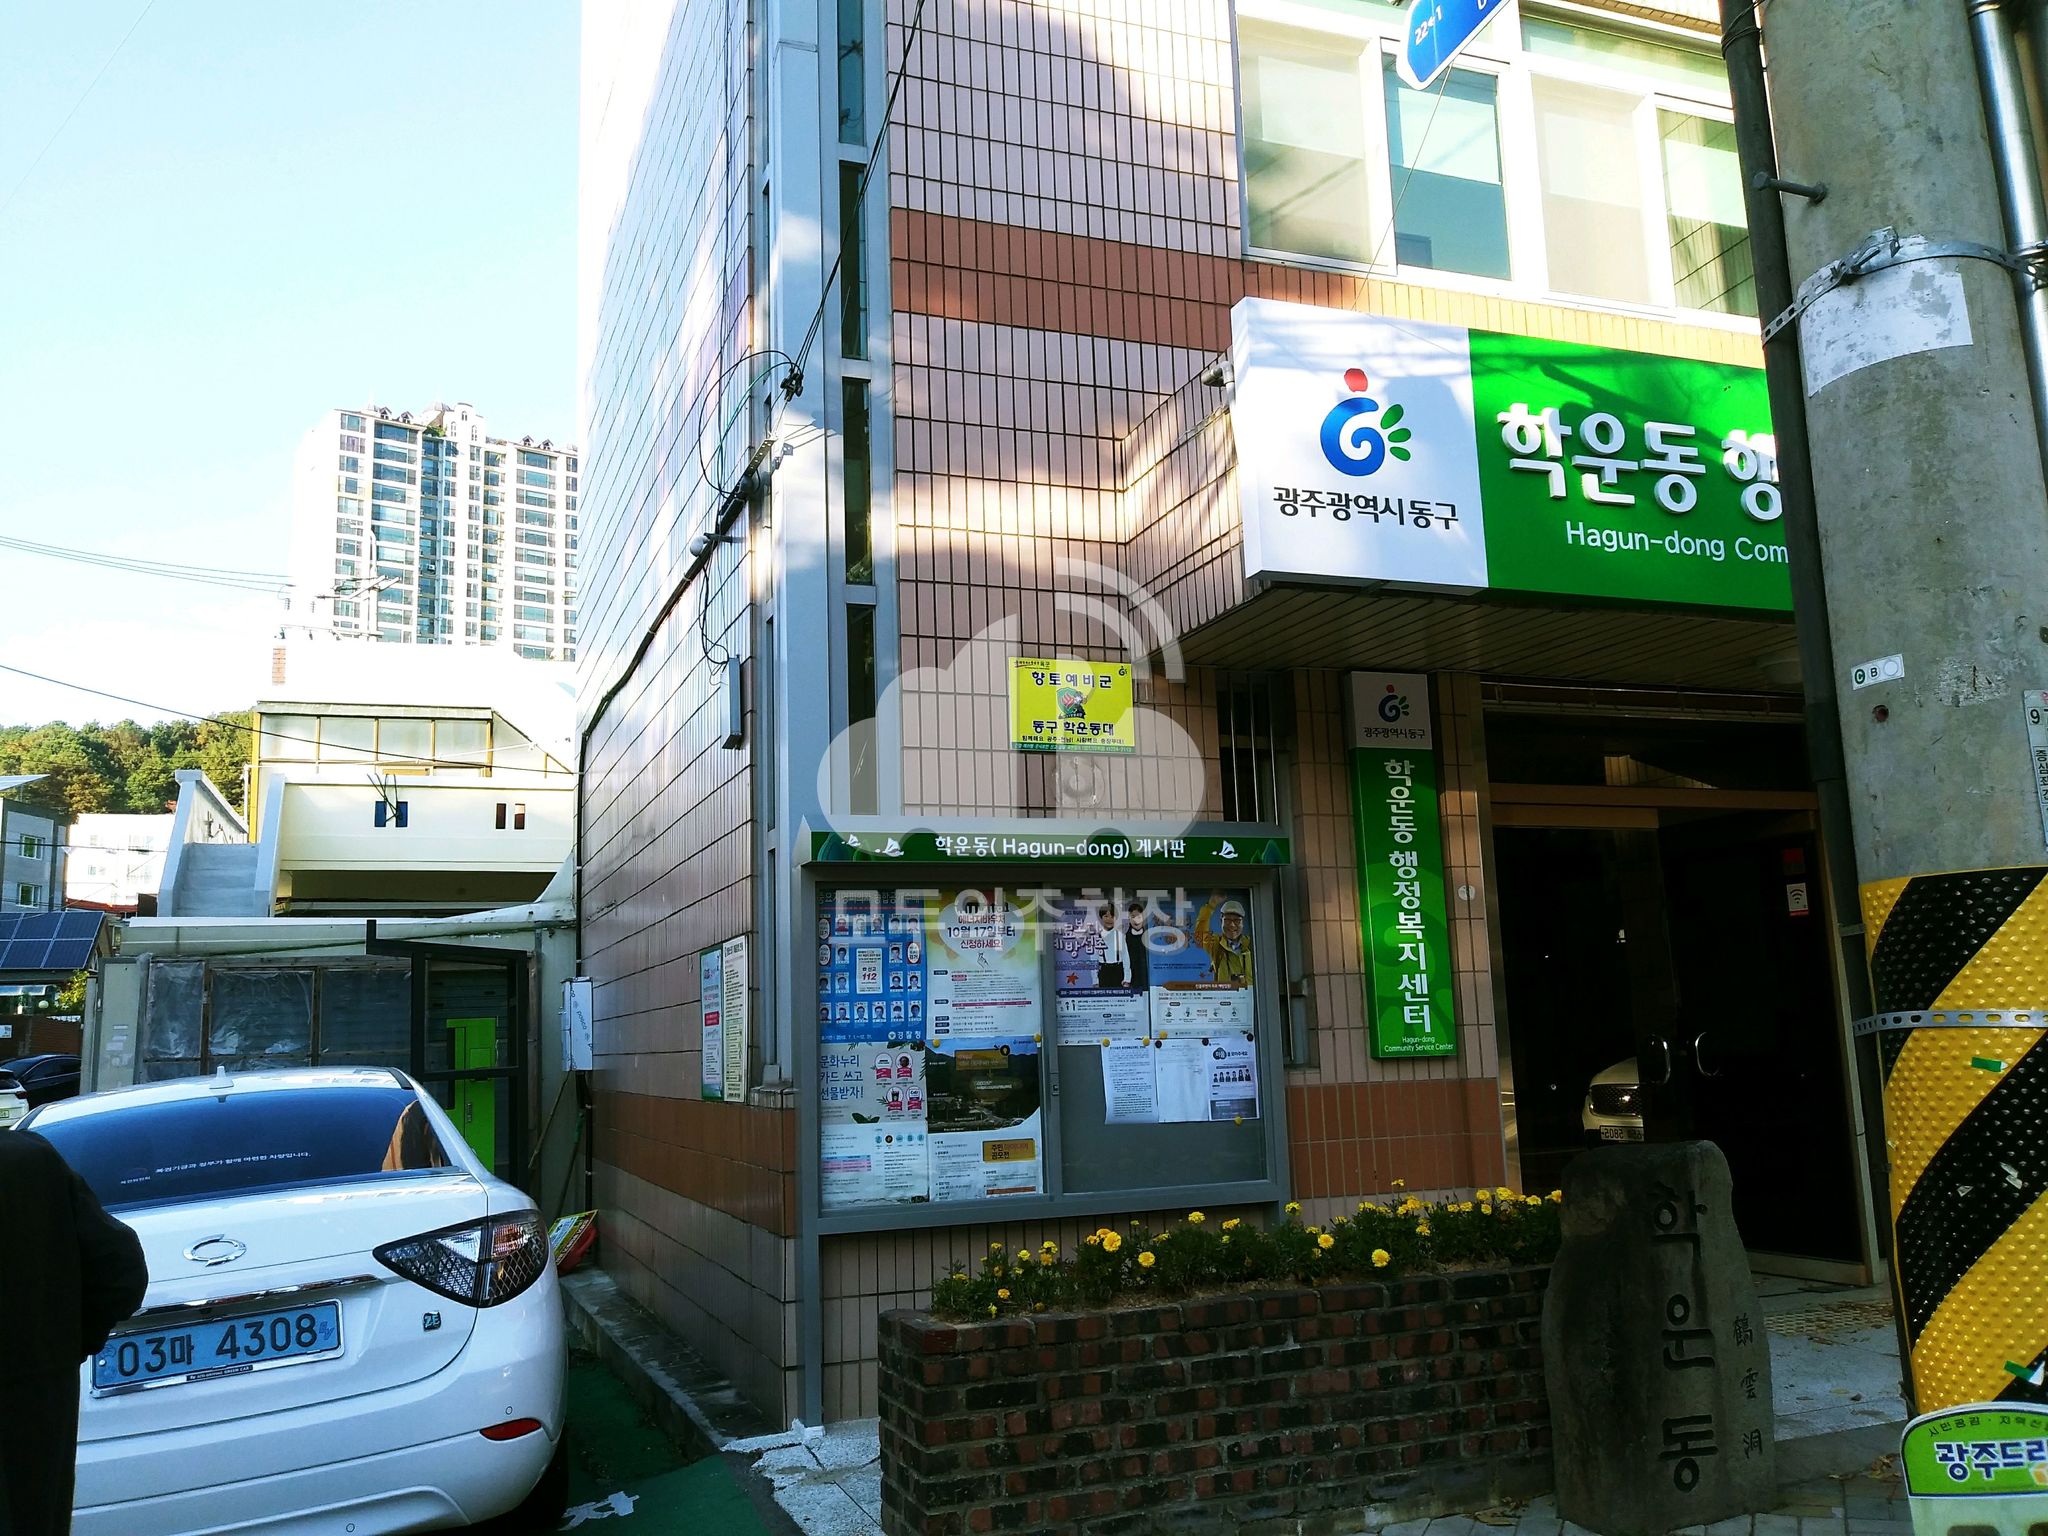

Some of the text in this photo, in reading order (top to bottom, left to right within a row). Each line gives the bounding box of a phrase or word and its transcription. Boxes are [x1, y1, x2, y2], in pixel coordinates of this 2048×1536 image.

[1496, 402, 1706, 514] 학운동
[1273, 486, 1459, 531] 광주광역시동구
[1566, 520, 1789, 564] Hagun-dong Com
[1031, 670, 1112, 689] 향토예비군
[1033, 720, 1115, 736] 동구 학운동대
[1364, 727, 1426, 739] 광주광역시동구
[1136, 838, 1186, 859] 게시판
[1384, 760, 1432, 1033] 학운동 행정복지센터
[947, 925, 1016, 938] 10월 17일부터
[1384, 1042, 1454, 1052] Community Service Center
[1402, 1036, 1436, 1044] Hagun-dong
[820, 1055, 860, 1068] 문화누리
[820, 1071, 864, 1084] 카드 쓰고
[820, 1086, 865, 1101] 선물받자!
[117, 1313, 318, 1377] 03마 4308
[1929, 1416, 1981, 1438] 시민공감
